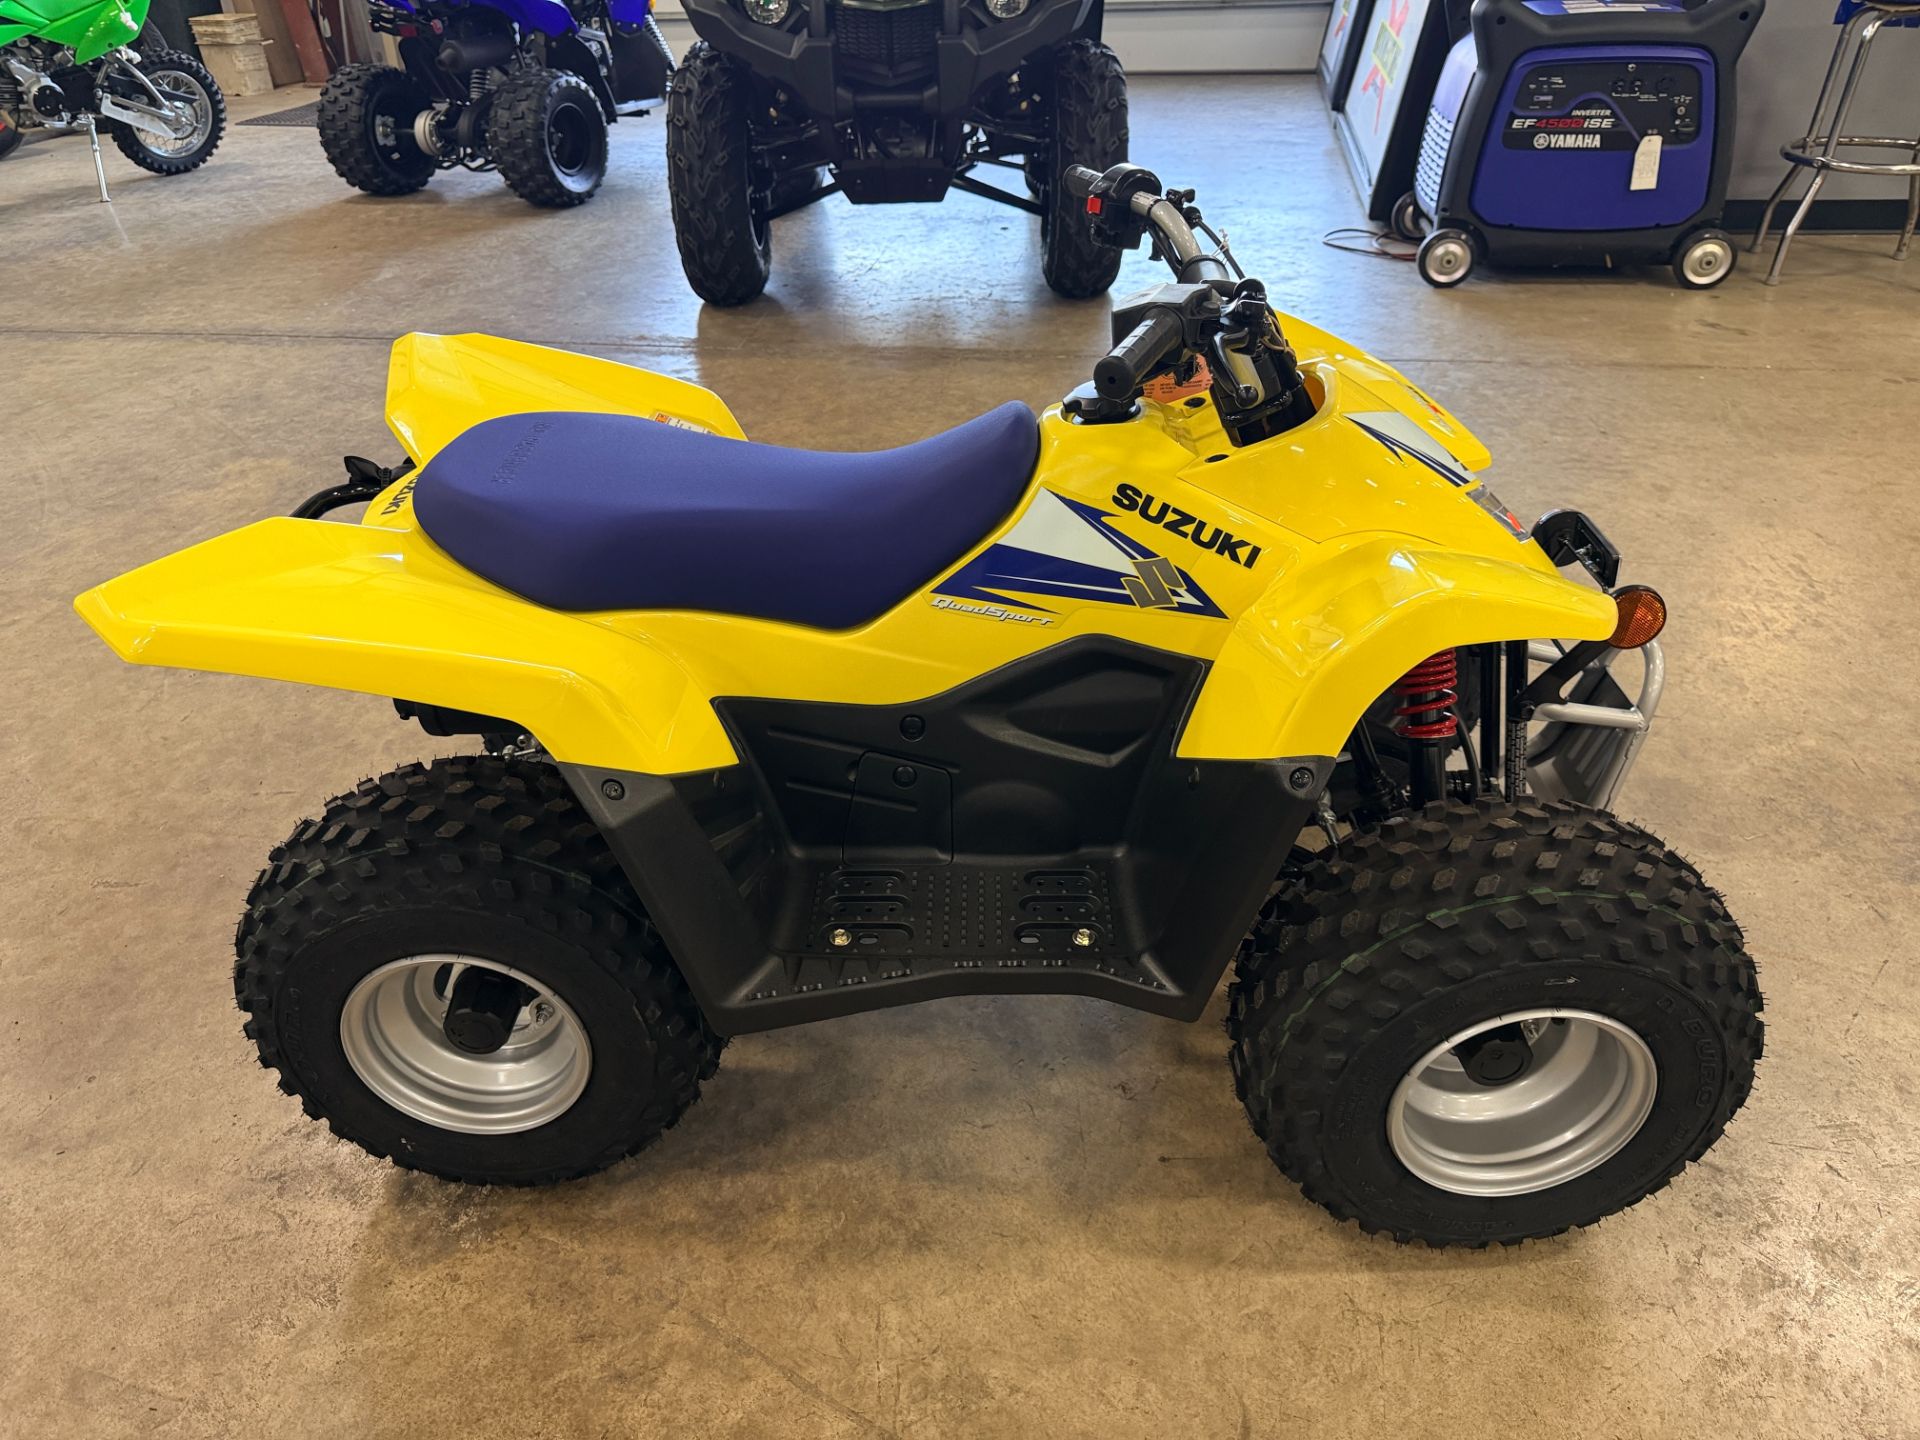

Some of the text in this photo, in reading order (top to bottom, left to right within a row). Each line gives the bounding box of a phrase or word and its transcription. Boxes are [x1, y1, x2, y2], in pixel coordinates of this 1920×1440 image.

[1571, 109, 1612, 117] INVERTER
[1549, 133, 1601, 149] YAMAHA
[1111, 482, 1262, 570] SUZUKI
[929, 596, 1055, 626] QuadSport
